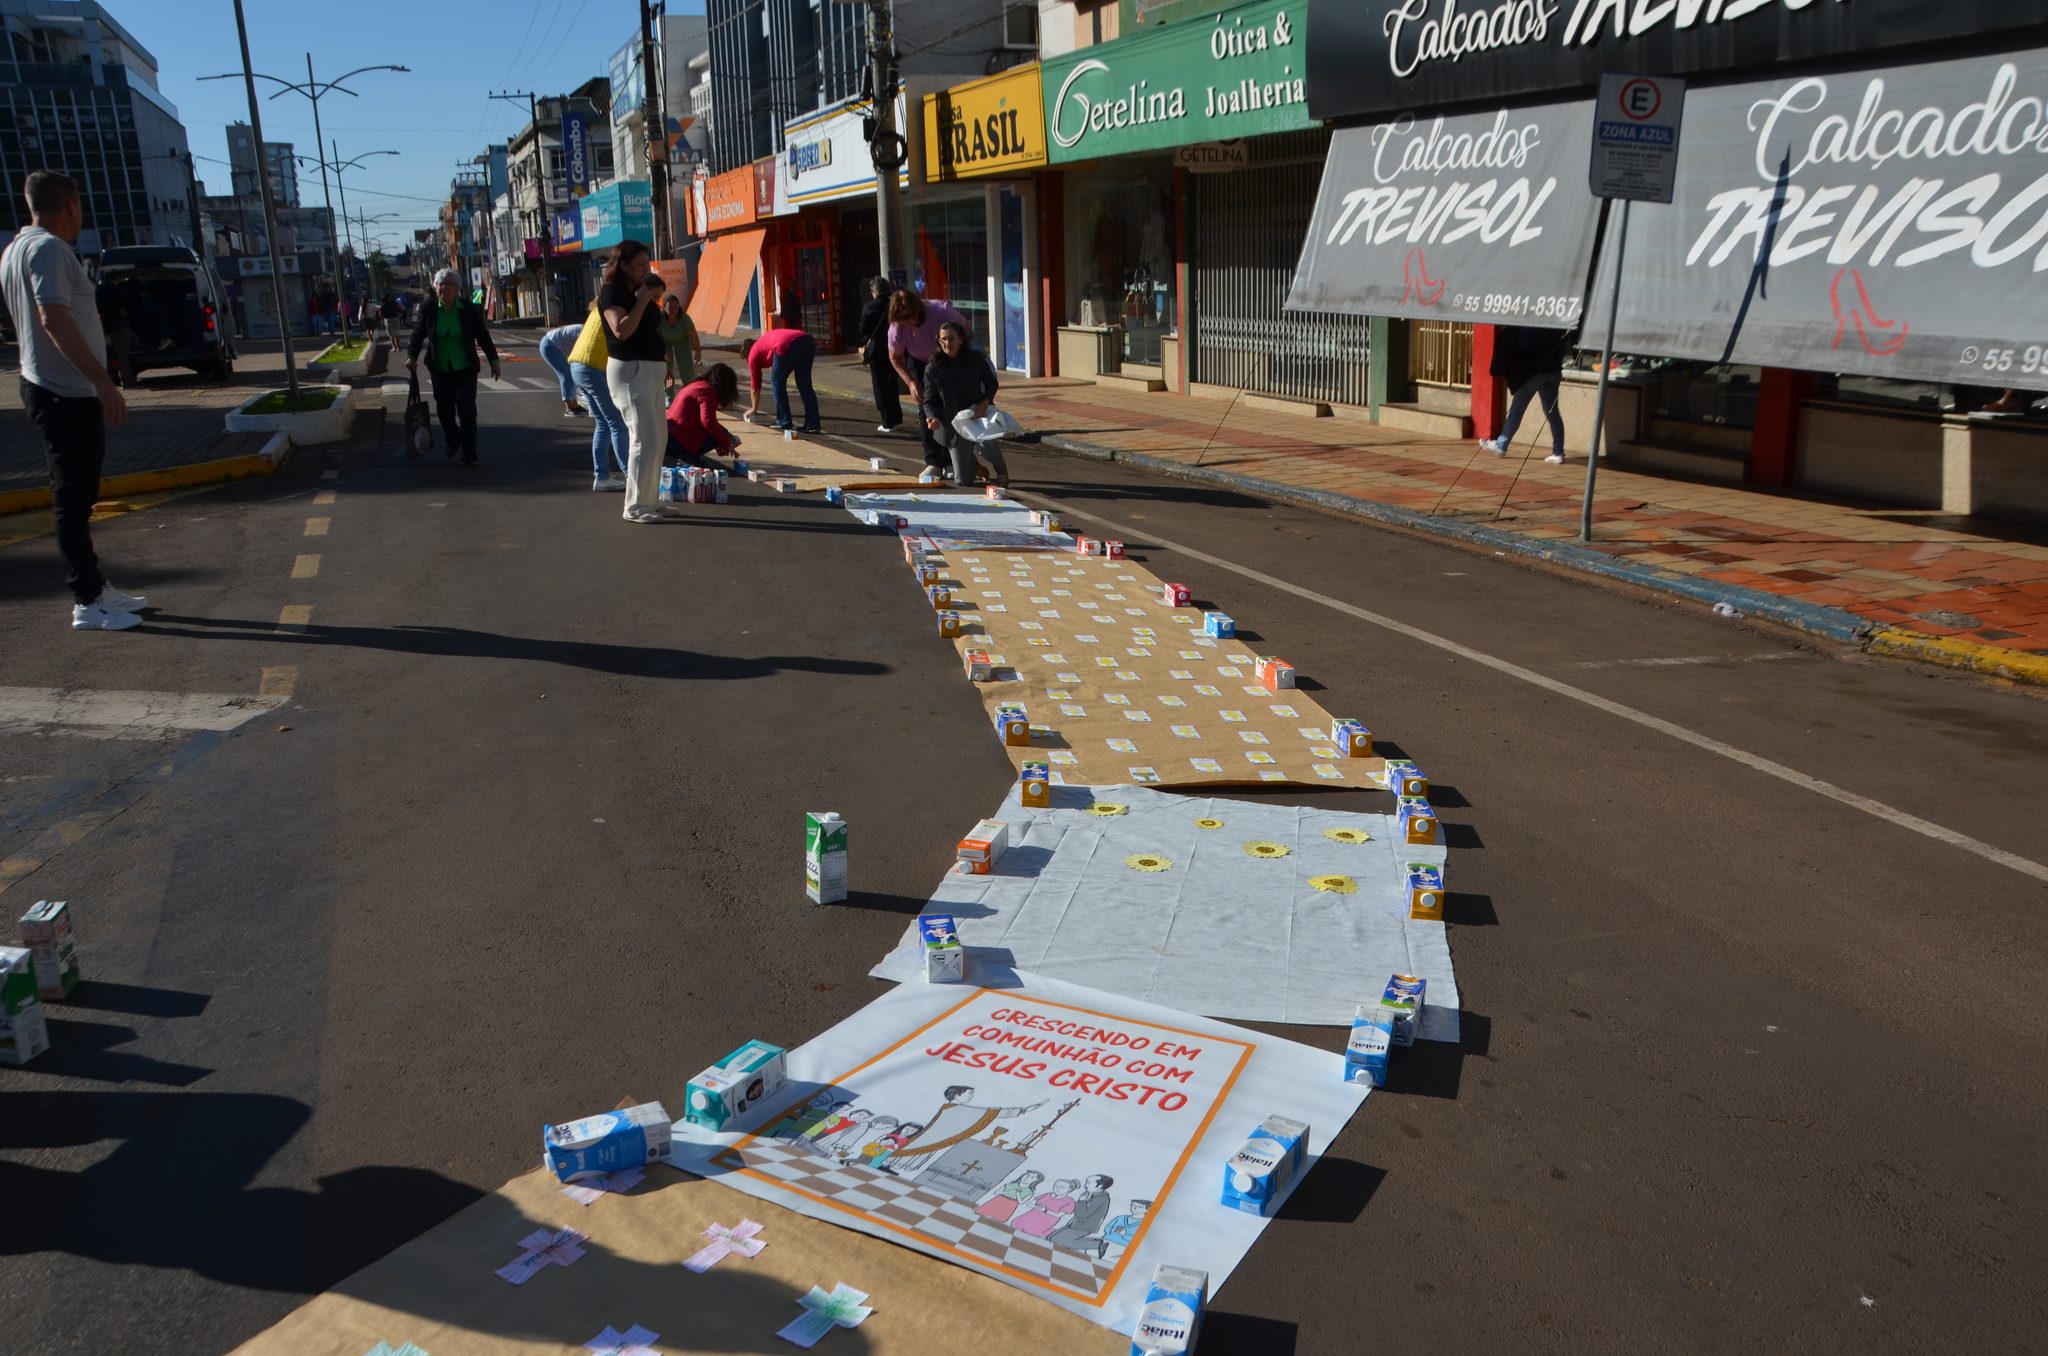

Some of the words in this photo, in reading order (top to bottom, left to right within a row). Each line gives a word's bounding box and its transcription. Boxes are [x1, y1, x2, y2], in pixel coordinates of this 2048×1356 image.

[1211, 13, 1268, 60] Ótica
[1273, 11, 1293, 45] &
[1383, 0, 1559, 78] Calçados
[942, 105, 962, 121] asa
[1052, 59, 1187, 148] Getelina
[1205, 65, 1307, 117] Joalheria
[1631, 87, 1649, 111] E
[941, 107, 1025, 165] BRASIL
[1371, 109, 1541, 184] Calçados
[1601, 124, 1637, 139] ZONA
[1640, 127, 1671, 143] AZUL
[1747, 62, 2048, 182] Calçado
[570, 120, 584, 184] Colombo
[1180, 147, 1243, 162] GETELINA
[1326, 177, 1557, 247] TREVISOL
[1685, 172, 2048, 272] TREVISO
[1464, 296, 1479, 312] 55
[1483, 293, 1579, 317] 99941-8367
[1982, 348, 2015, 372] 55
[961, 1025, 1122, 1068] COMUNHÃO
[1125, 1059, 1195, 1084] COM
[990, 1007, 1151, 1051] CRESCENDO
[1153, 1042, 1202, 1062] EM
[925, 1041, 1047, 1081] JESUS
[1048, 1068, 1189, 1113] CRISTO
[1236, 1152, 1274, 1168] Italac
[1140, 1323, 1185, 1340] Italac
